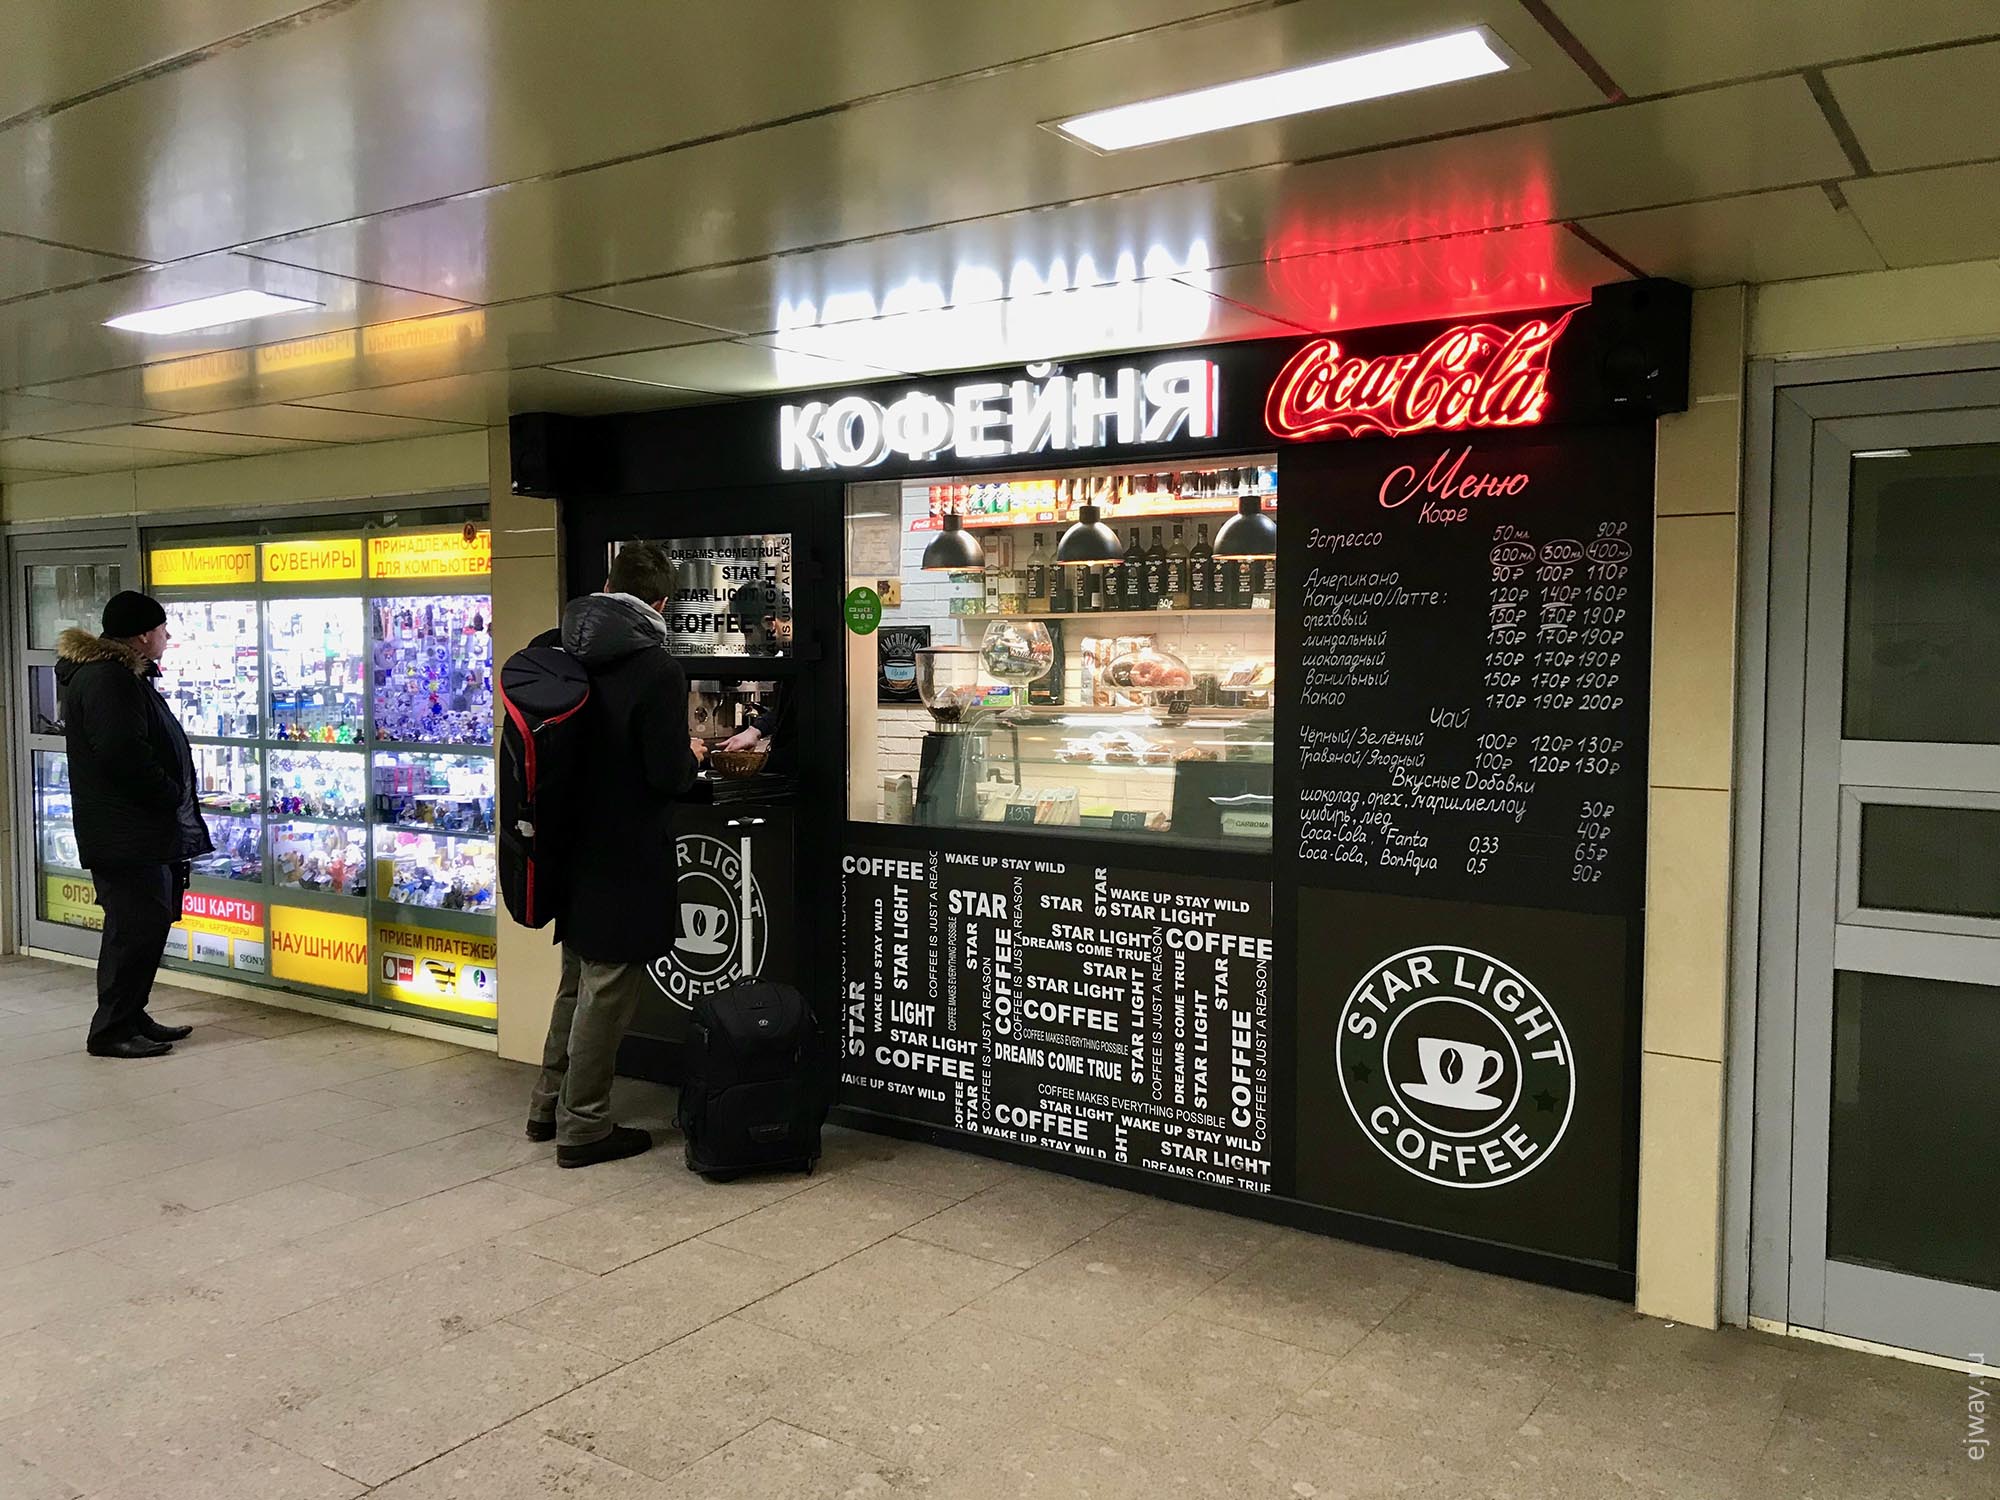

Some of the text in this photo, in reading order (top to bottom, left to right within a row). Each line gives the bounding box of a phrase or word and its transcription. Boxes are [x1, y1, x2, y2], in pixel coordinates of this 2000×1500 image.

[779, 360, 1219, 471] КОФЕЙНЯ
[1379, 445, 1530, 509] Меню
[1418, 501, 1468, 527] Кофе
[671, 546, 781, 560] DREAMS COME TRUE
[1306, 528, 1383, 554] Эспрессо
[182, 551, 252, 575] Минипорт
[270, 550, 356, 572] СУВЕНИРЫ
[376, 557, 492, 577] ДЛЯ КОМПЬЮТЕРА
[721, 566, 760, 580] STAR
[1303, 567, 1399, 591] Американо
[782, 587, 791, 621] JUST
[670, 613, 753, 633] COFFEE
[1303, 608, 1369, 631] ореховый
[1302, 631, 1387, 654] миндальный
[1302, 651, 1386, 673] шоколадный
[1305, 668, 1390, 686] ванильный
[1300, 686, 1346, 705] Какао
[1430, 707, 1470, 728] Чай
[1299, 746, 1425, 773] Травяной/Ягодный
[1392, 766, 1536, 795] Вкусные Добавки
[1411, 795, 1527, 823] маршмеллоу
[1385, 828, 1429, 848] Fanta
[1469, 836, 1499, 855] 0,33
[842, 855, 924, 881] COFFEE
[945, 852, 1066, 874] WAKE UP STAY WILD
[1380, 848, 1438, 877] BonAqua
[1466, 857, 1488, 875] 0,5
[948, 889, 1008, 920] STAR
[1040, 894, 1083, 912] STAR
[1095, 867, 1107, 918] STAR
[1110, 887, 1250, 913] WAKE UP STAY WILD
[182, 893, 255, 922] ЭШ КАРТЫ
[1110, 902, 1217, 927] STAR LIGHT
[271, 930, 367, 966] НАУШНИКИ
[380, 928, 497, 961] ПРИЕМ ПЛАТЕЖЕЙ
[893, 884, 908, 990] STAR LIGHT
[966, 922, 978, 970] STAR
[1051, 923, 1152, 948] STAR LIGHT
[1166, 928, 1273, 961] COFFEE
[239, 953, 265, 966] SONY
[1022, 936, 1152, 963] DREAMS COME TRUE
[399, 966, 413, 976] МТС
[995, 928, 1012, 1035] COFFEE
[1083, 961, 1128, 980] STAR
[1027, 975, 1125, 1001] STAR LIGHT
[1215, 958, 1229, 1011] STAR
[849, 981, 865, 1057] STAR
[891, 999, 936, 1028] LIGHT
[1023, 999, 1119, 1033] COFFEE
[1347, 955, 1566, 1066] STAR LIGHT
[1131, 967, 1144, 1084] STAR LIGHT
[890, 1029, 978, 1056] STAR LIGHT
[1194, 990, 1208, 1109] STAR LIGHT
[875, 1046, 975, 1081] COFFEE
[994, 1042, 1122, 1082] DREAMS COME TRUE
[1231, 1010, 1251, 1128] COFFEE
[995, 1104, 1088, 1141] COFFEE
[1040, 1099, 1114, 1123] STAR LIGHT
[1121, 1115, 1261, 1152] WAKE UP STAY WILD
[1370, 1104, 1539, 1177] COFFEE
[1160, 1141, 1271, 1175] STAR LIGHT
